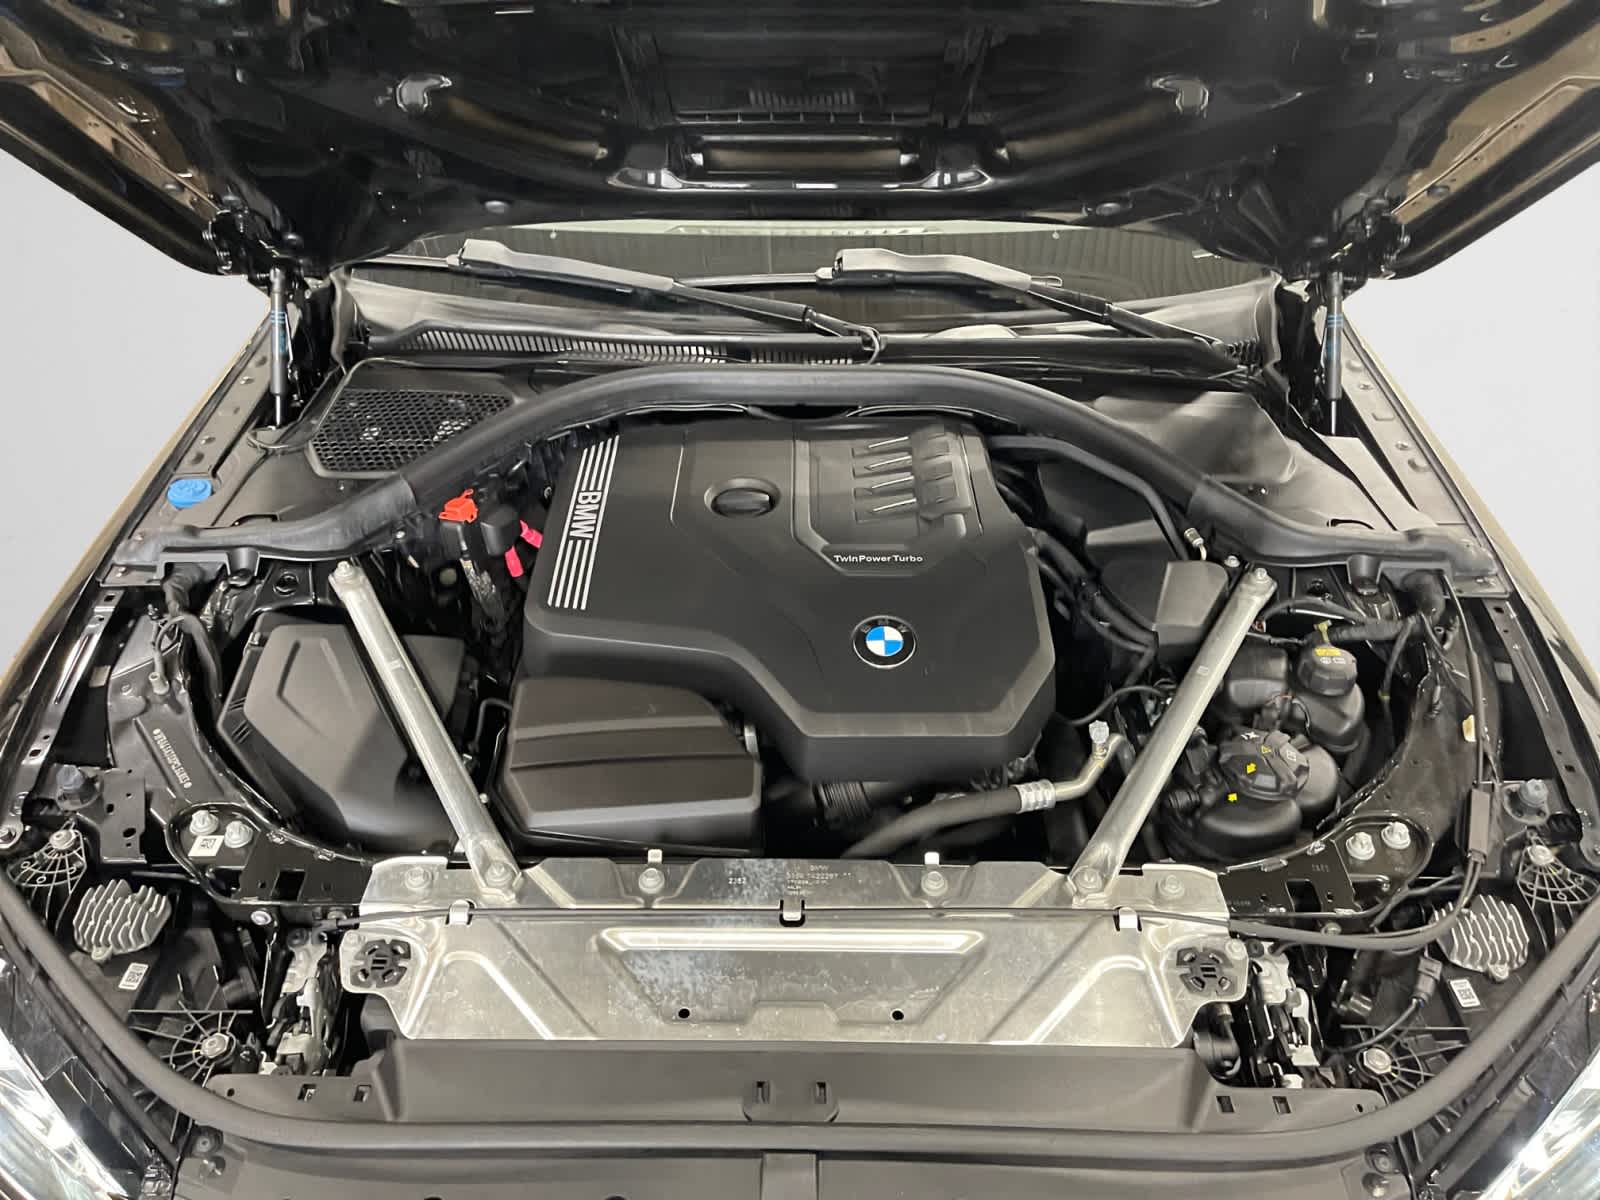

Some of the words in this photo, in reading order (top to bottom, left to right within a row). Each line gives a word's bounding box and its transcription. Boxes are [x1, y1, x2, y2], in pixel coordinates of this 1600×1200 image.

[570, 491, 602, 538] BMW
[833, 554, 891, 563] TwinPower
[892, 554, 923, 562] Turbo
